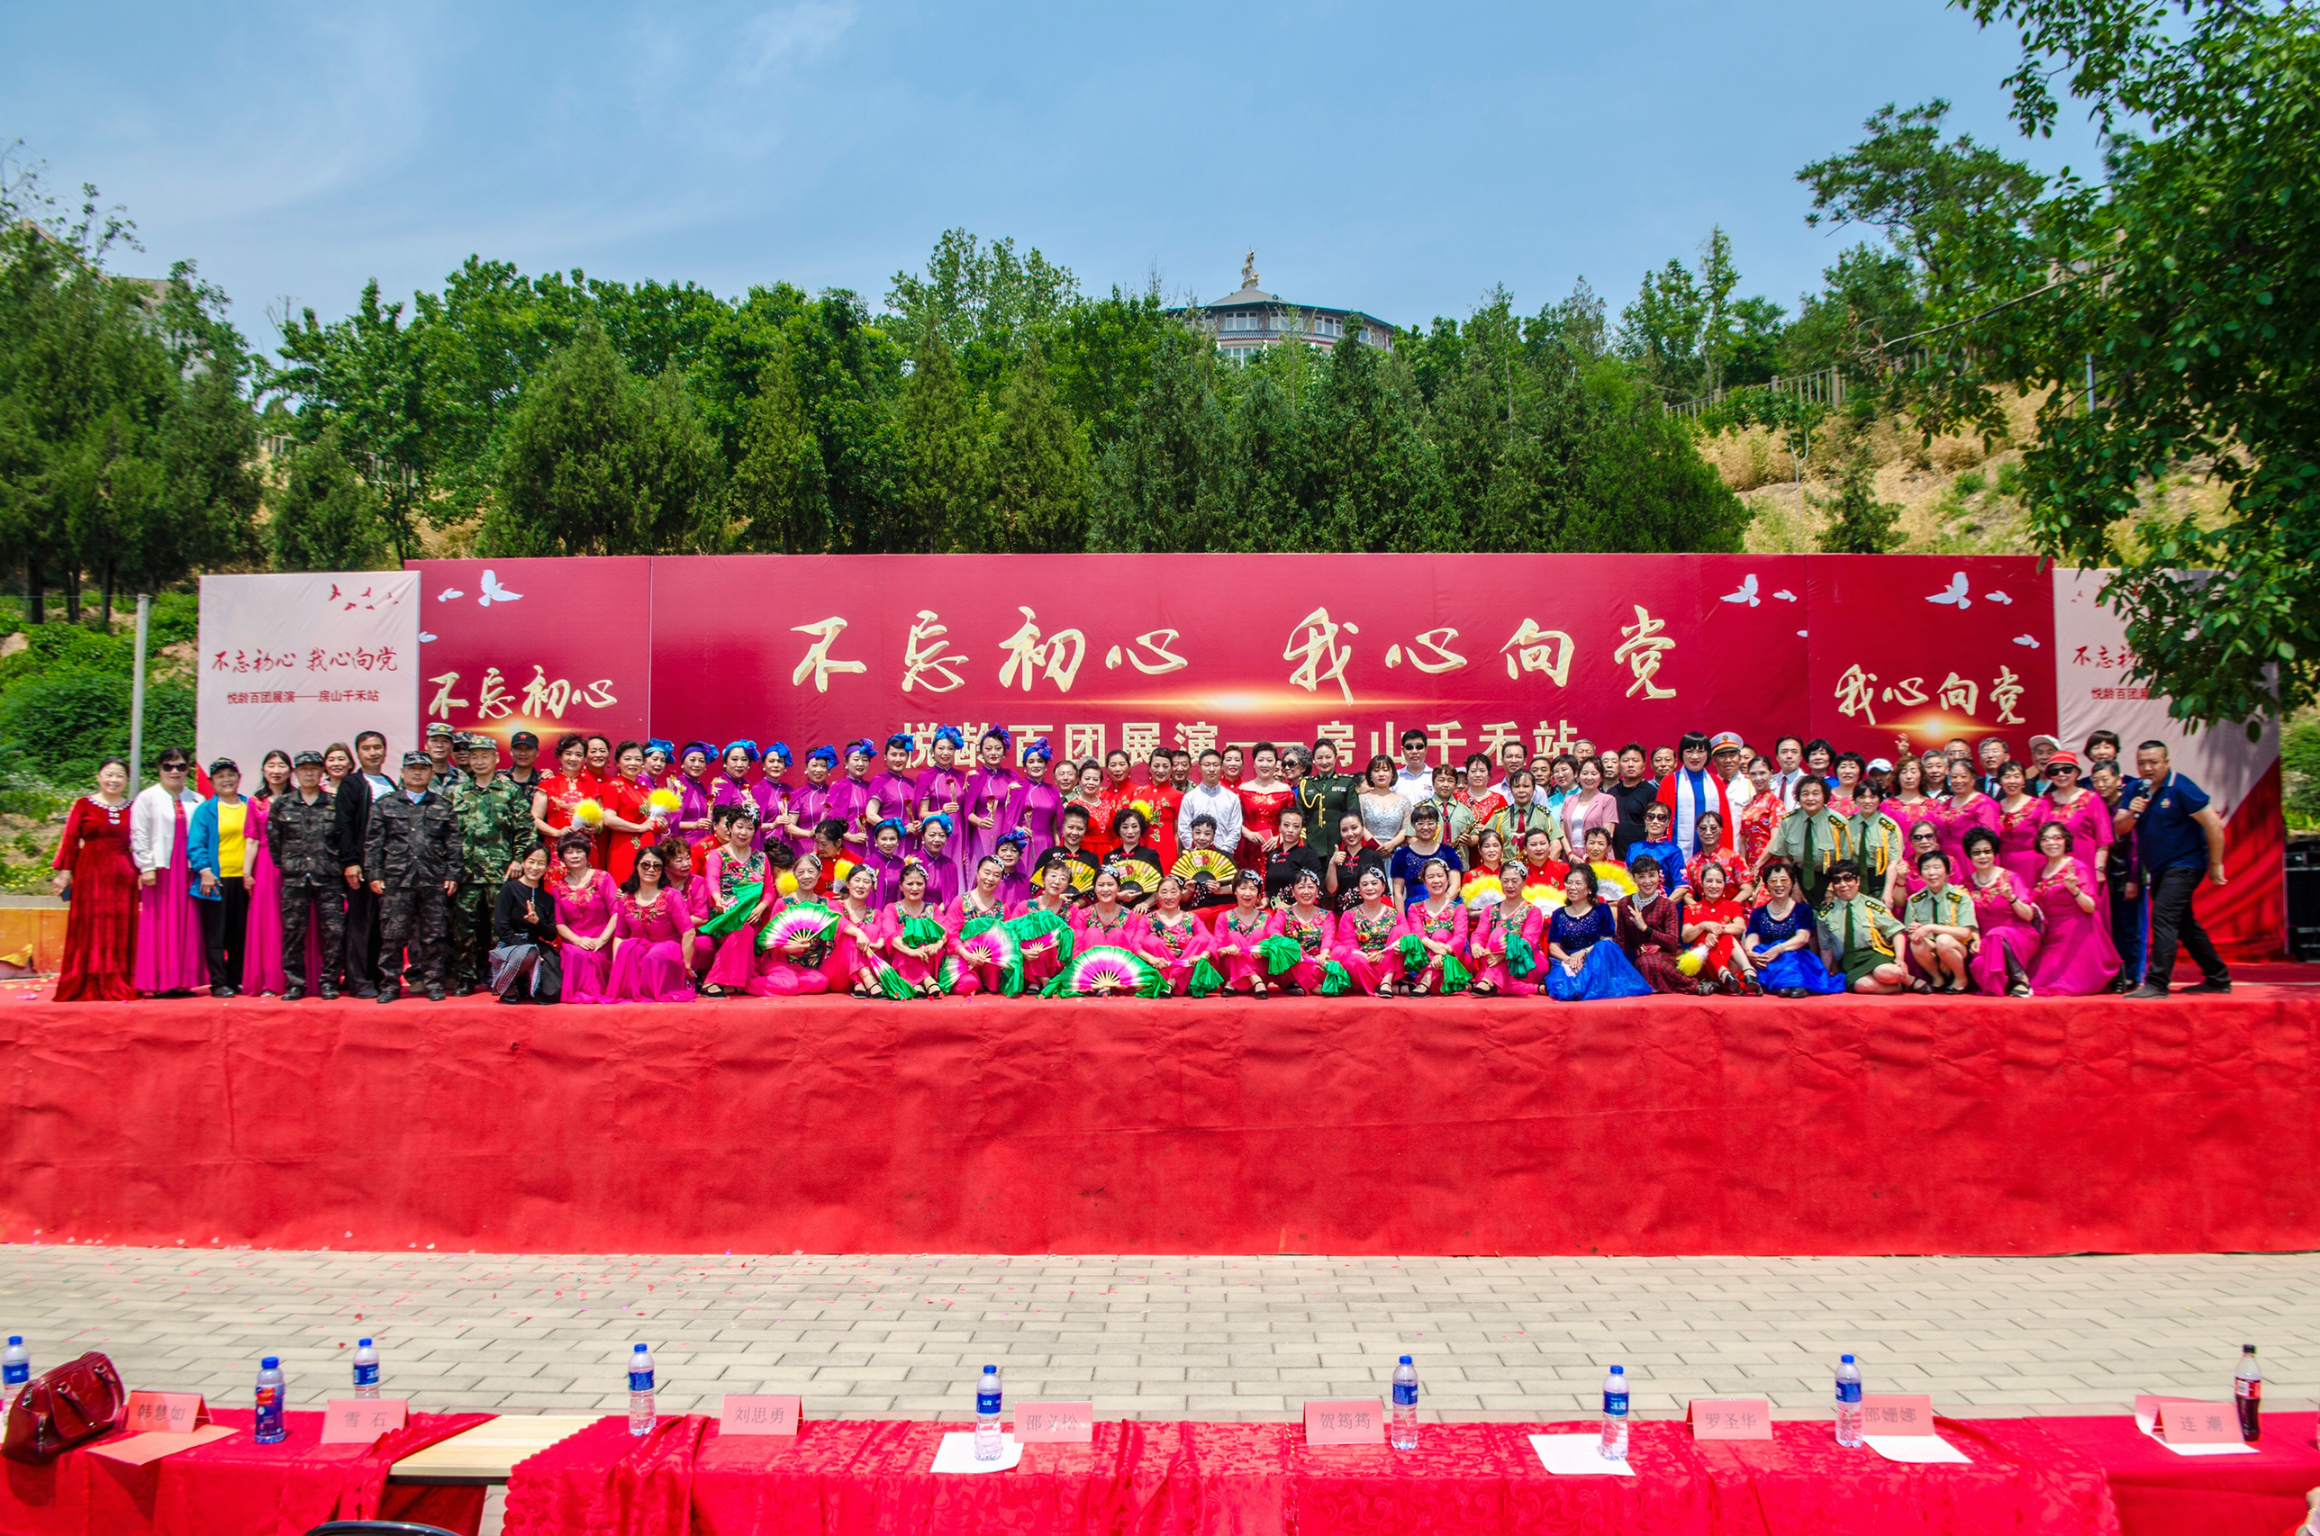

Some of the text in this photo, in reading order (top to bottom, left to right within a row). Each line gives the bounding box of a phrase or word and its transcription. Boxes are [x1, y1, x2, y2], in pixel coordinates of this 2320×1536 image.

[211, 646, 399, 674] 不忘初心 我心向党
[790, 604, 1677, 706] 不忘初心 我心向党
[428, 664, 618, 720] 不忘初心
[1834, 663, 2026, 726] 我心向党
[136, 1403, 186, 1422] 韩慧如
[733, 1406, 785, 1425] 刘思勇
[1704, 1412, 1758, 1431] 罗圣华
